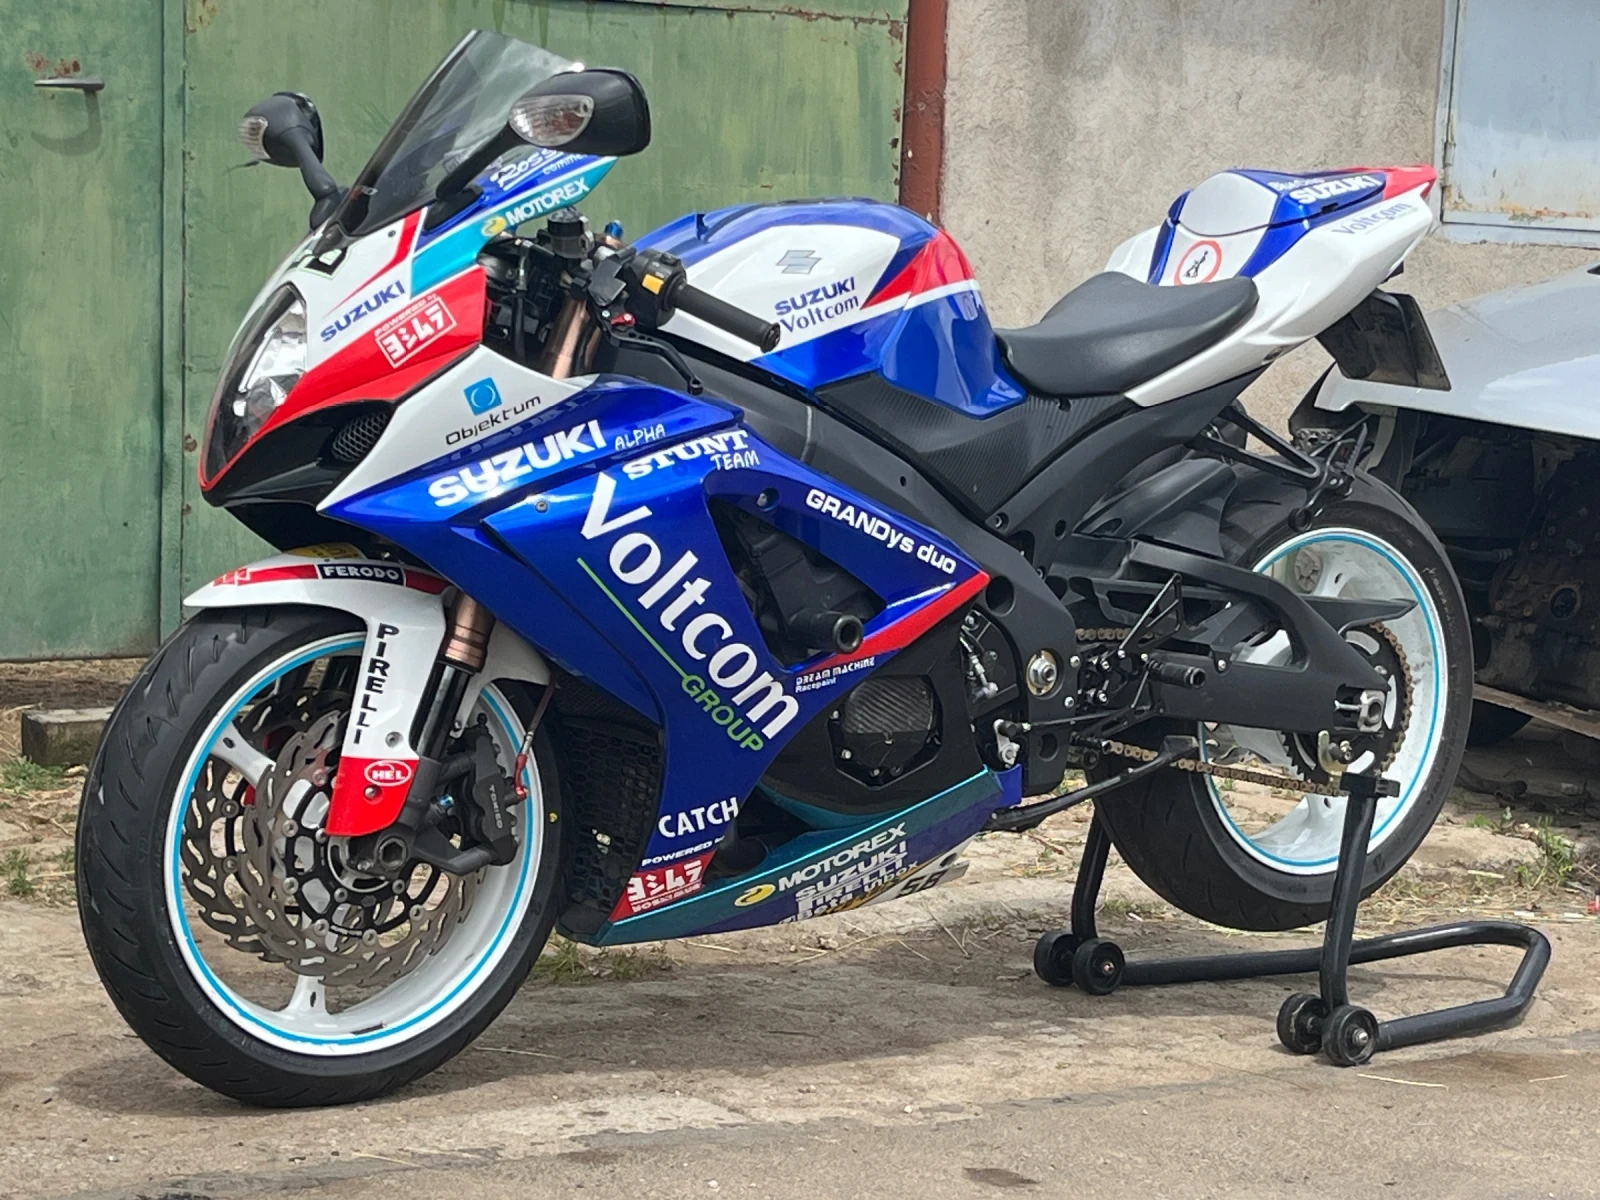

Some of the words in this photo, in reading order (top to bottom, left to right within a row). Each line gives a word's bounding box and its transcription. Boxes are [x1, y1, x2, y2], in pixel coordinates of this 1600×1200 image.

[505, 177, 590, 226] MOTOREX
[1290, 175, 1383, 204] SUZUKI
[1331, 203, 1412, 235] Voltcom
[320, 280, 406, 343] SUZUKI
[775, 277, 855, 316] SUZUKI
[780, 294, 860, 334] Voltcom
[382, 304, 446, 361] ヨシムラ
[445, 395, 541, 446] Objektum
[614, 424, 666, 451] ALPHA
[428, 419, 607, 507] SUZUKI
[622, 430, 748, 480] STUNT
[710, 450, 761, 471] TEAM
[806, 489, 914, 553] GRANDys
[917, 545, 956, 574] duo
[323, 566, 399, 580] FERODO
[581, 472, 799, 739] Voltcom
[353, 623, 399, 745] PIRELLI
[681, 675, 764, 751] GROUP
[372, 770, 406, 780] HEL
[658, 797, 738, 838] CATCH
[641, 841, 713, 866] POWERED
[778, 822, 906, 892] MOTOREX
[795, 841, 906, 898] SUZUKI
[627, 860, 702, 902] ヨシムラ
